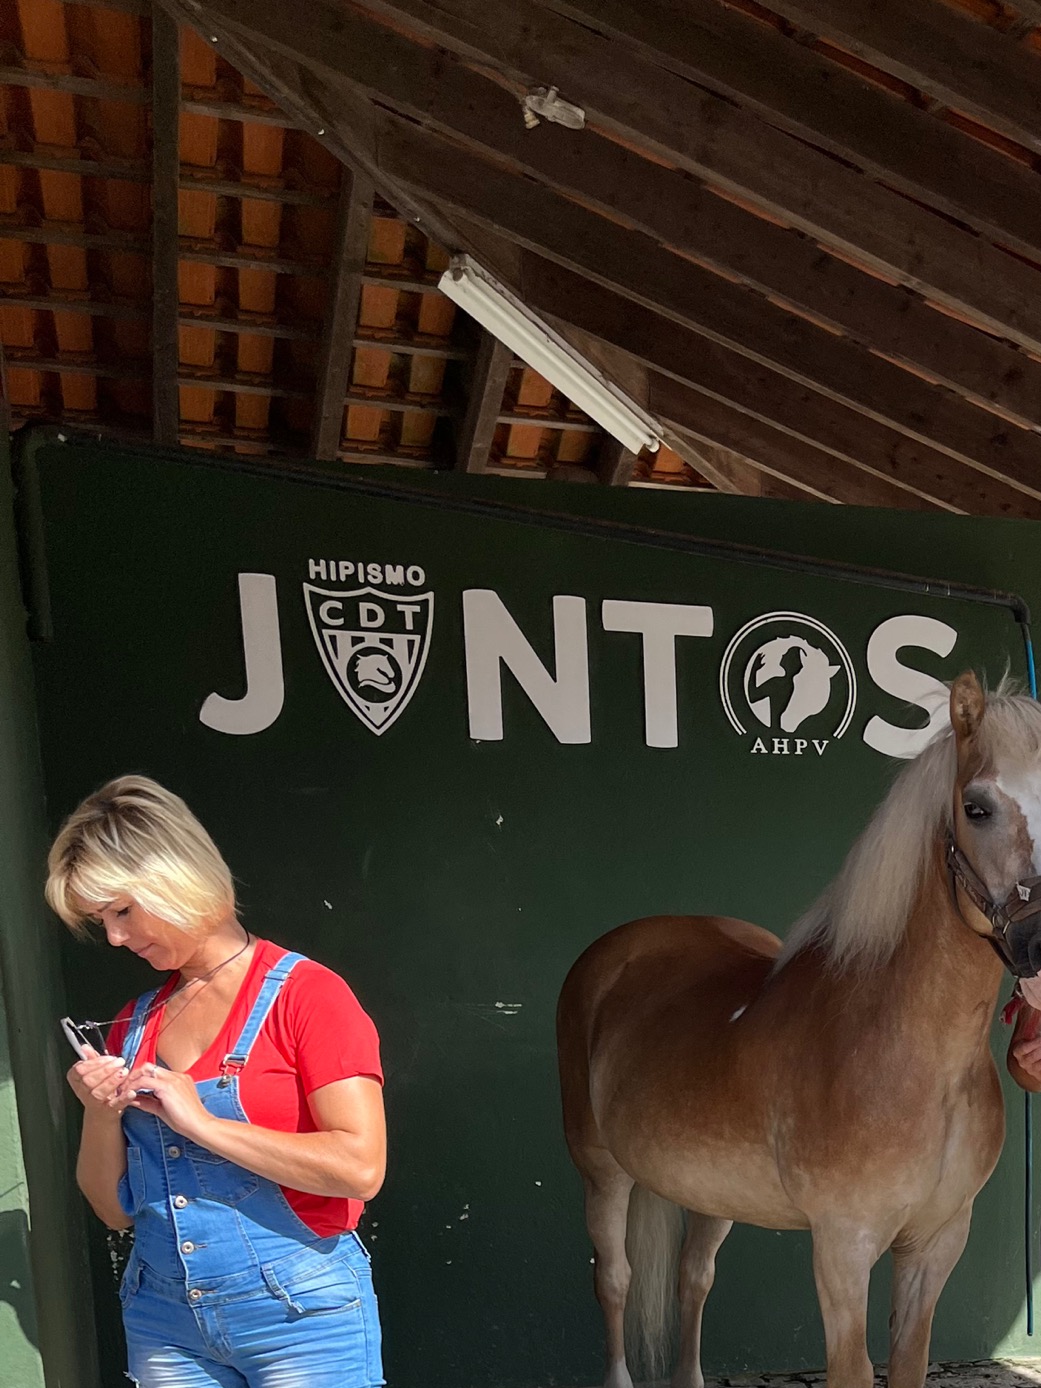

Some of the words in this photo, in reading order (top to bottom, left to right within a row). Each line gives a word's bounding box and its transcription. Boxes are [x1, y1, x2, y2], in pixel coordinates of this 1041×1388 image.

[308, 558, 426, 587] HIPISMO
[319, 600, 421, 631] CDT
[750, 736, 829, 756] AHPV
